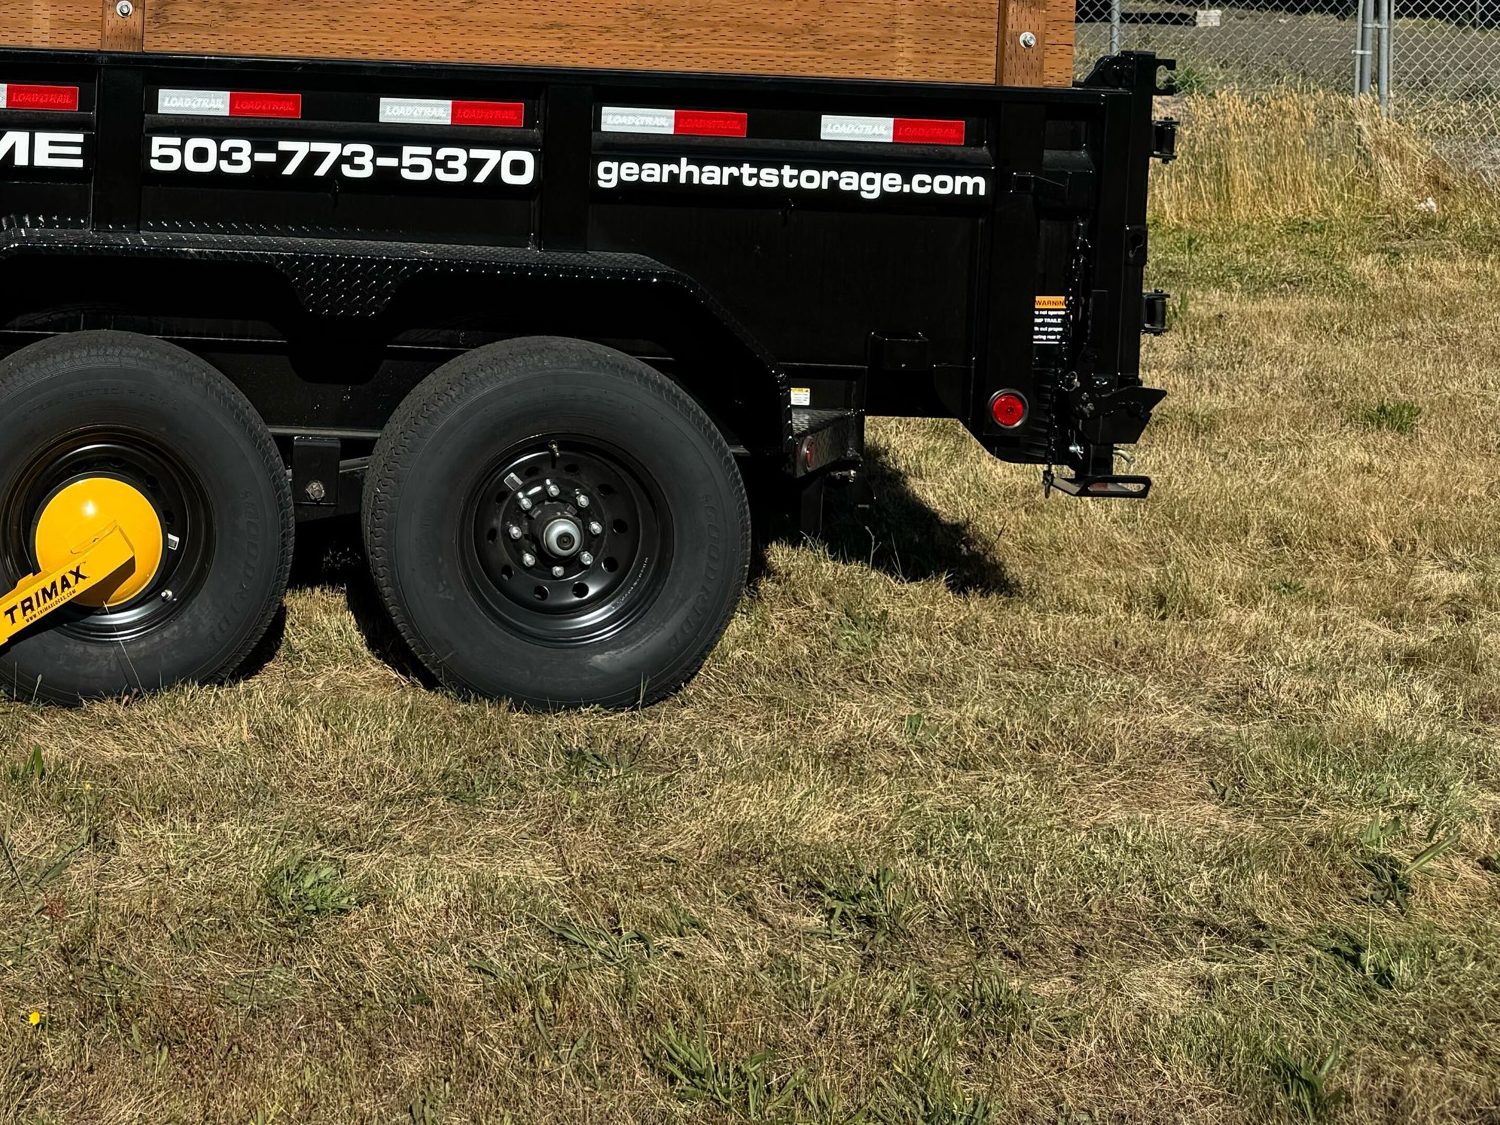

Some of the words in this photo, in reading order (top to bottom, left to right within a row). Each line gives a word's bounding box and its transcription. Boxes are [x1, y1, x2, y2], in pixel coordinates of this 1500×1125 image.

[150, 136, 535, 185] 503-773-5370
[597, 157, 986, 199] gearhartstorage.com
[4, 564, 89, 626] TRIMAX
